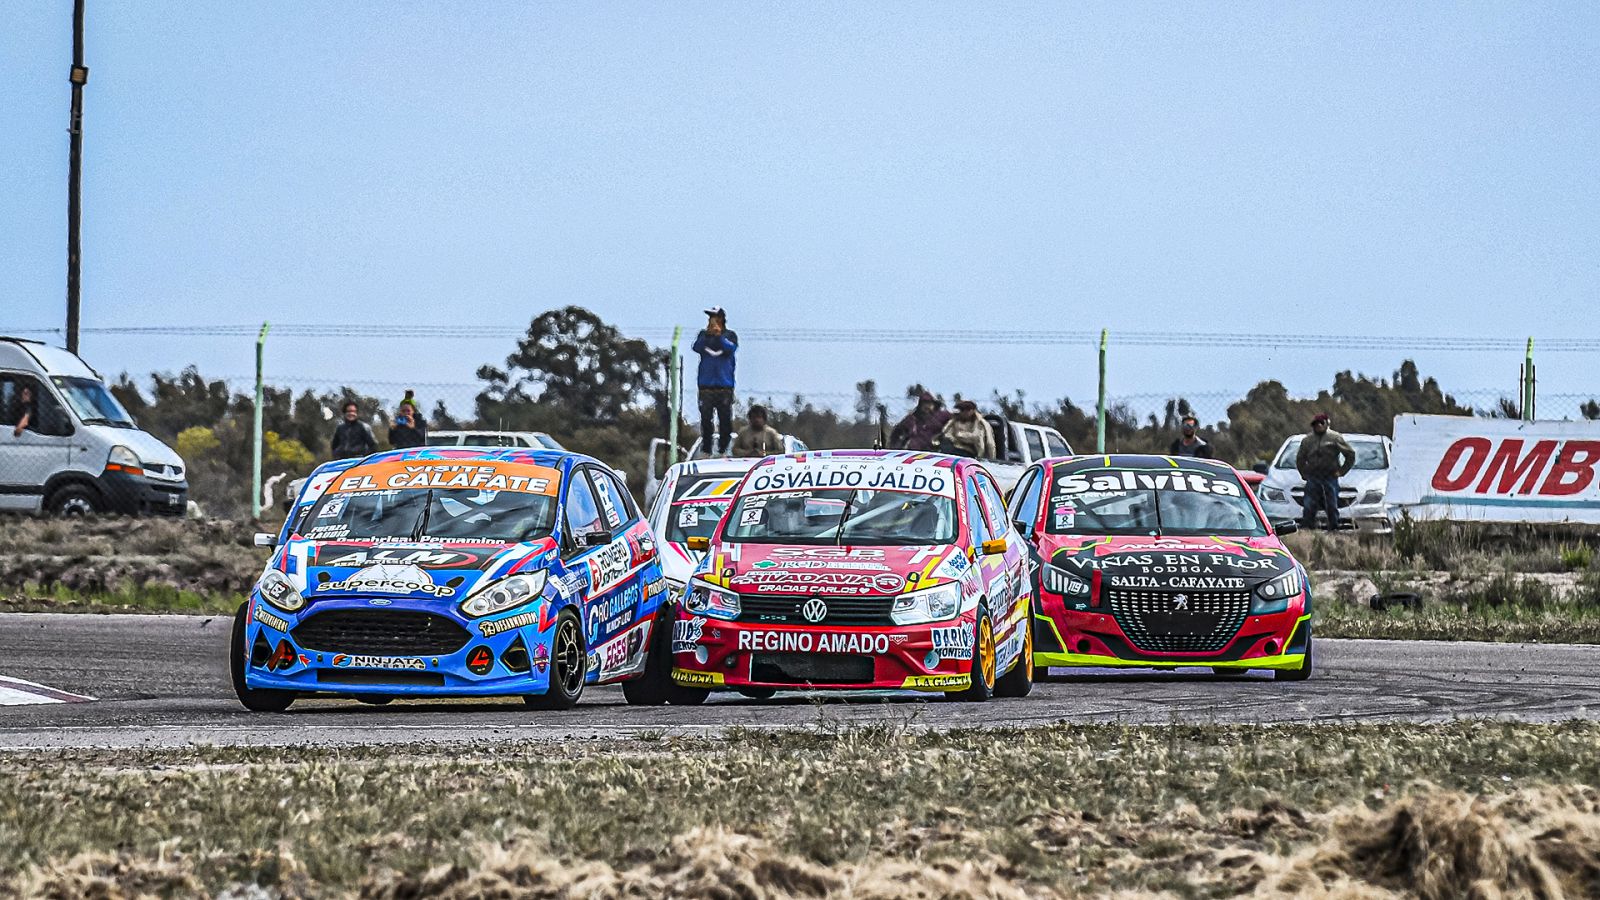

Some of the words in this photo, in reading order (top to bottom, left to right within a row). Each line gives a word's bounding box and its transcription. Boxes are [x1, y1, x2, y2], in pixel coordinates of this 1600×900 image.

[405, 465, 496, 473] VISITE
[766, 464, 942, 476] GOBERNADOR
[1431, 436, 1600, 496] OMB
[339, 475, 378, 491] EL
[387, 472, 550, 493] CALAFATE
[754, 471, 863, 491] OSVALDO
[868, 472, 946, 492] JALDO
[1057, 471, 1241, 497] Salvita
[745, 491, 813, 503] ORTEGA
[303, 529, 351, 539] CLAUDIO
[597, 541, 627, 570] ROMERO
[1067, 554, 1154, 569] VIÑAS
[1164, 554, 1200, 566] EN
[1209, 554, 1280, 570] FLOR
[747, 574, 875, 587] RIVADAVIA
[1111, 576, 1159, 587] SALTA
[1169, 577, 1246, 589] CAFAYATE
[317, 578, 455, 598] supercoop
[809, 586, 857, 594] CARLOS
[609, 583, 639, 618] GALLEGOS
[738, 630, 812, 651] REGINO
[816, 633, 889, 654] AMADO
[933, 627, 968, 647] DARIO
[934, 647, 972, 658] MONTEROS
[354, 656, 425, 665] NINJATA
[914, 677, 932, 687] LA
